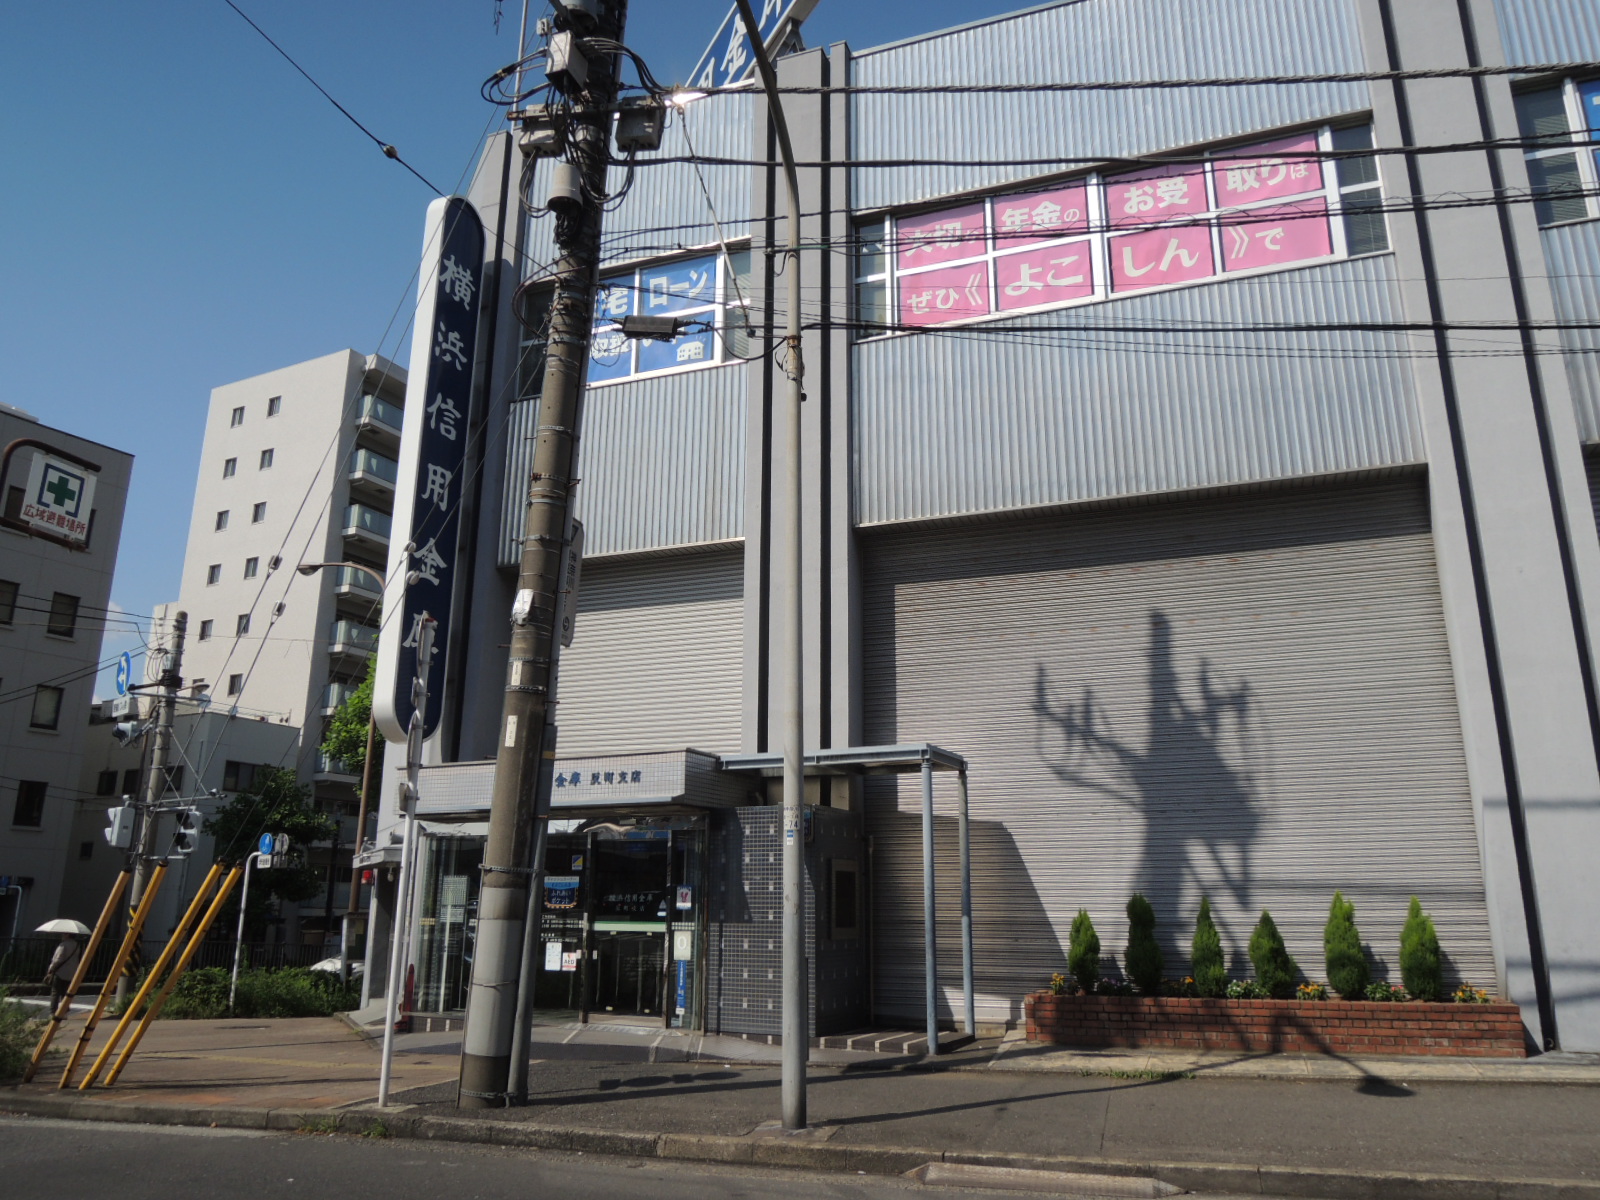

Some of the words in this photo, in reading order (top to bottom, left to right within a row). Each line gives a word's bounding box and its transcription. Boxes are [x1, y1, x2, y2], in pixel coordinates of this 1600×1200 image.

[22, 504, 86, 536] 広域避難場所
